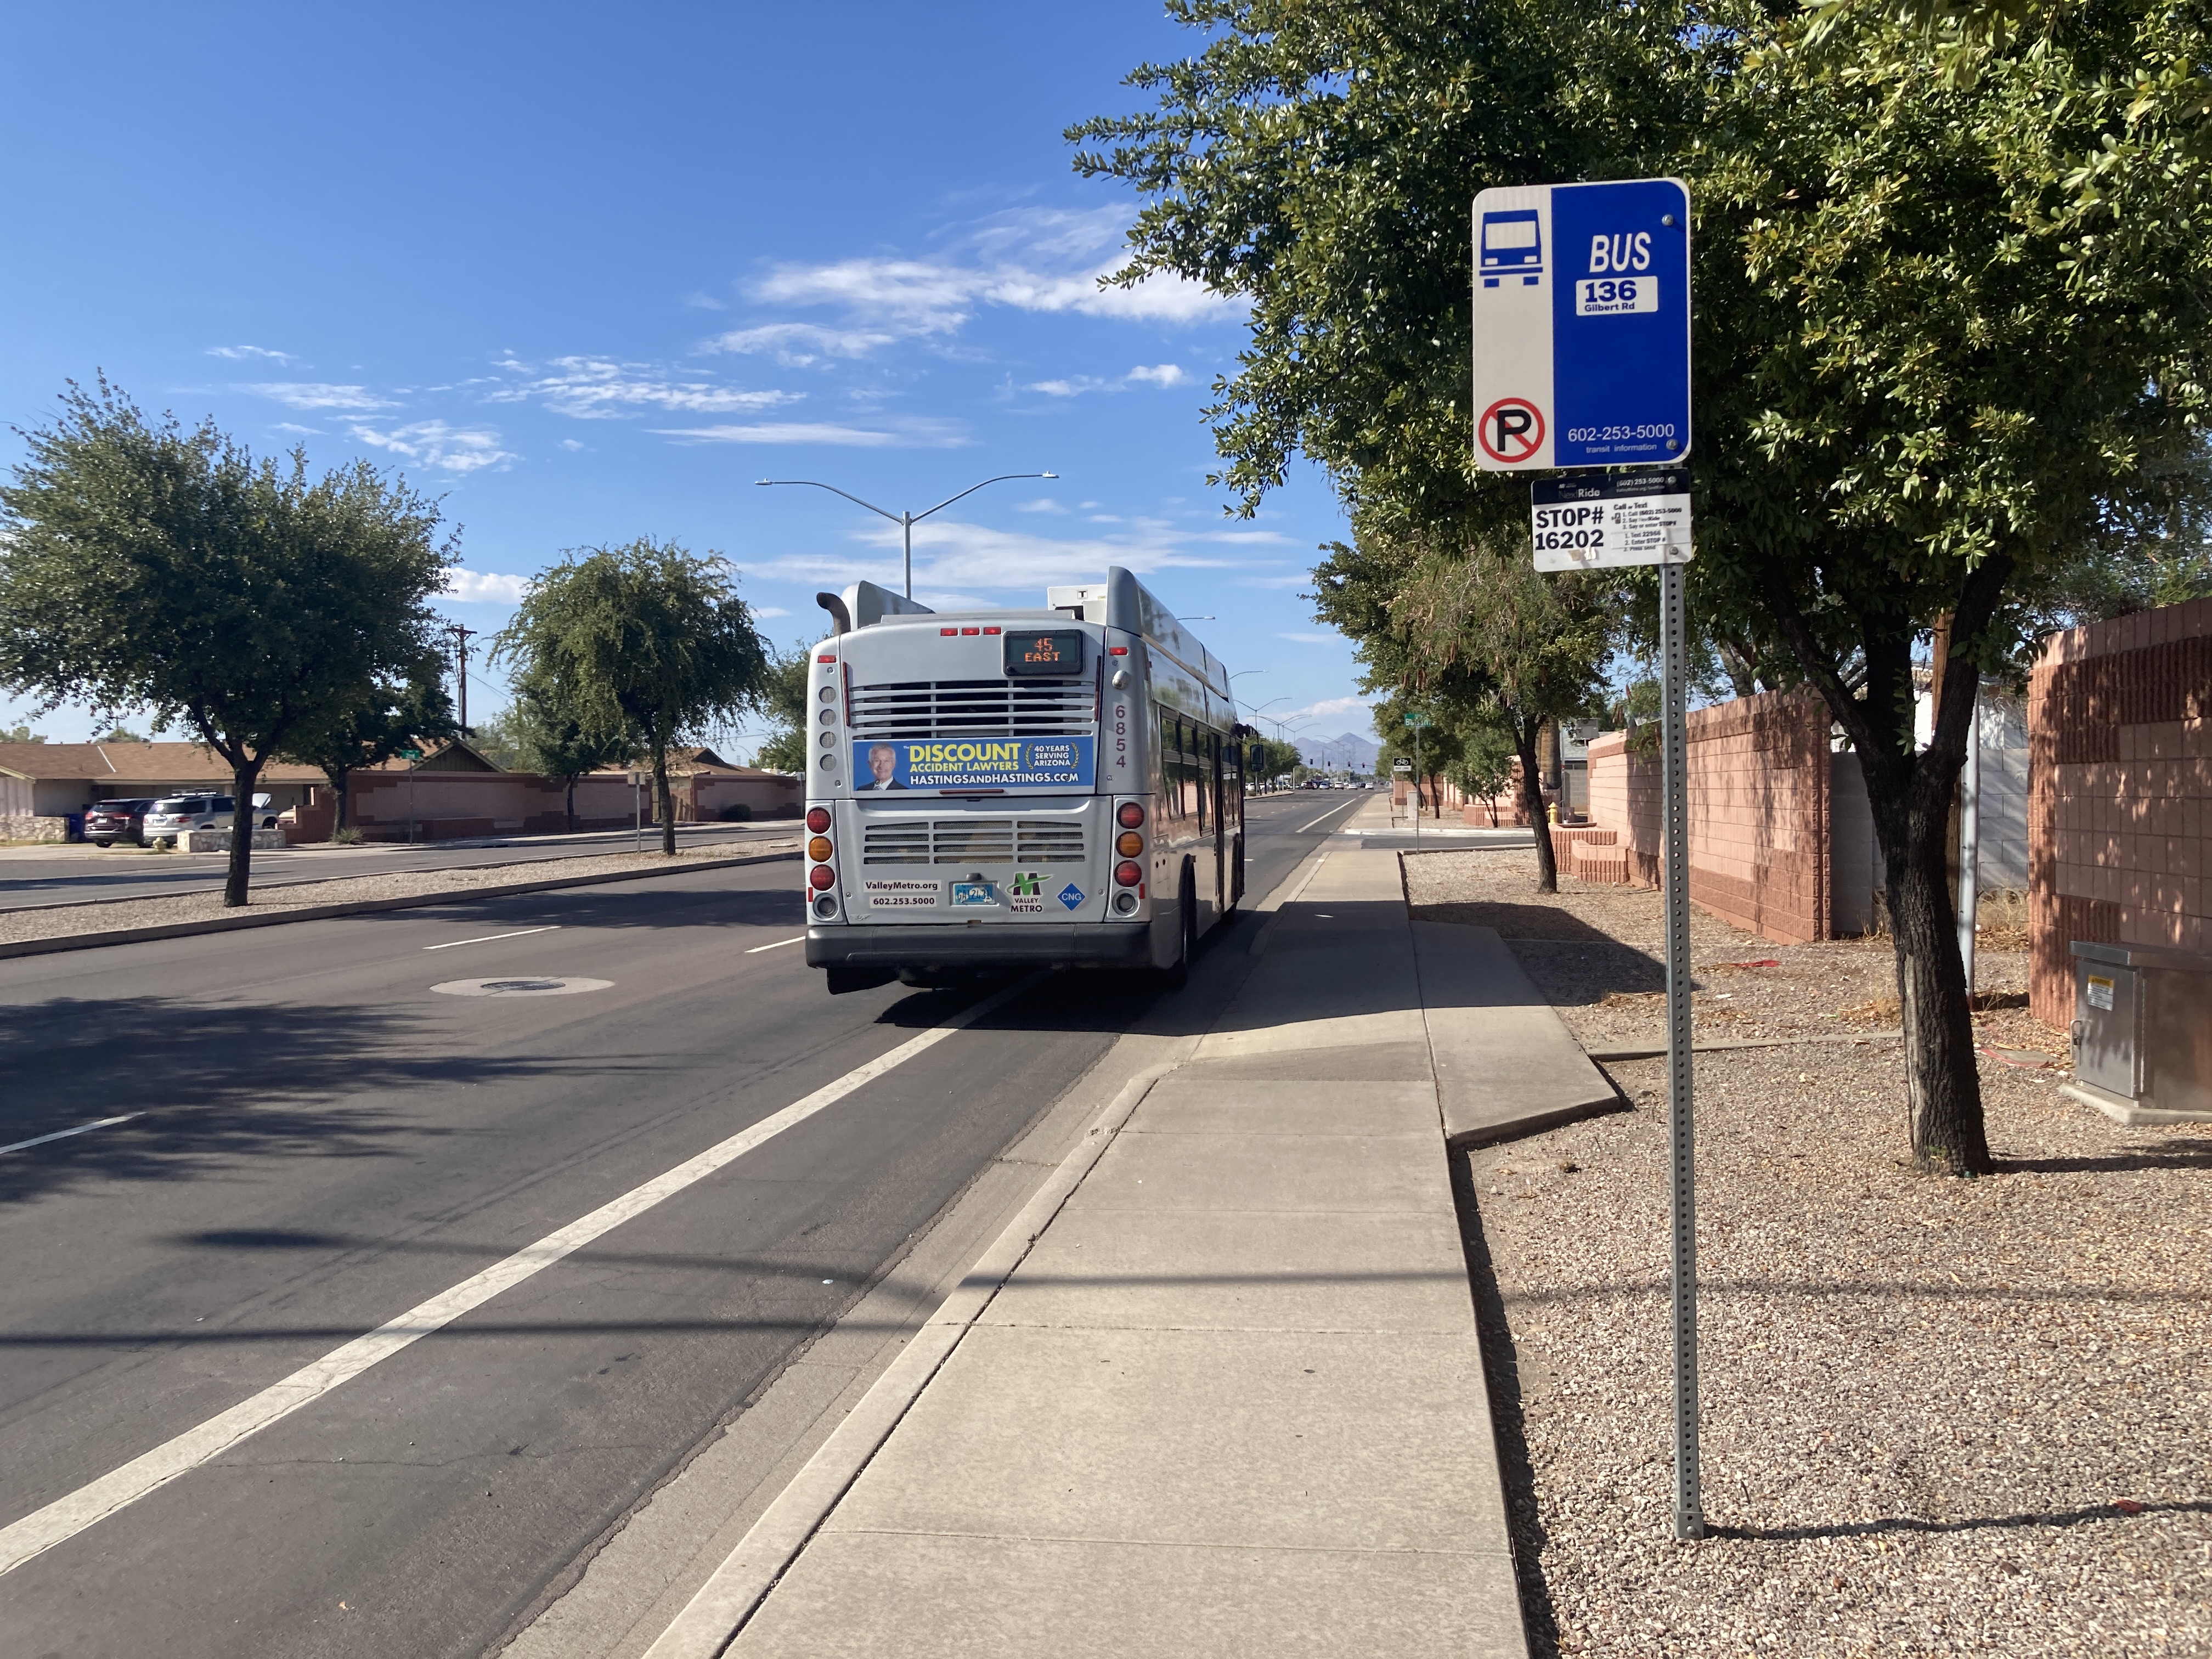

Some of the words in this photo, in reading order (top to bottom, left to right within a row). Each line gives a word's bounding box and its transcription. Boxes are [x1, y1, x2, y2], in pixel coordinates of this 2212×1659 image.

[1589, 232, 1651, 273] BUS
[1585, 280, 1637, 302] 136
[1584, 304, 1619, 312] Gilbert
[1497, 409, 1532, 452] P
[1568, 424, 1674, 442] 602-253-5000
[1587, 445, 1610, 453] transit
[1614, 443, 1657, 452] information
[1536, 506, 1604, 529] STOP#
[1536, 529, 1604, 550] 16202
[1035, 637, 1053, 651] 45
[1024, 651, 1060, 662] EAST
[1115, 705, 1126, 768] 6854
[910, 743, 1021, 763] DISCOUNT
[910, 763, 964, 772] ACCIDENT
[967, 761, 1019, 771] LAWYERS
[910, 772, 1079, 785] HASTINGSANDHASTINGS.COM
[866, 882, 938, 891] ValleyMetro.org
[1062, 893, 1082, 901] CNG
